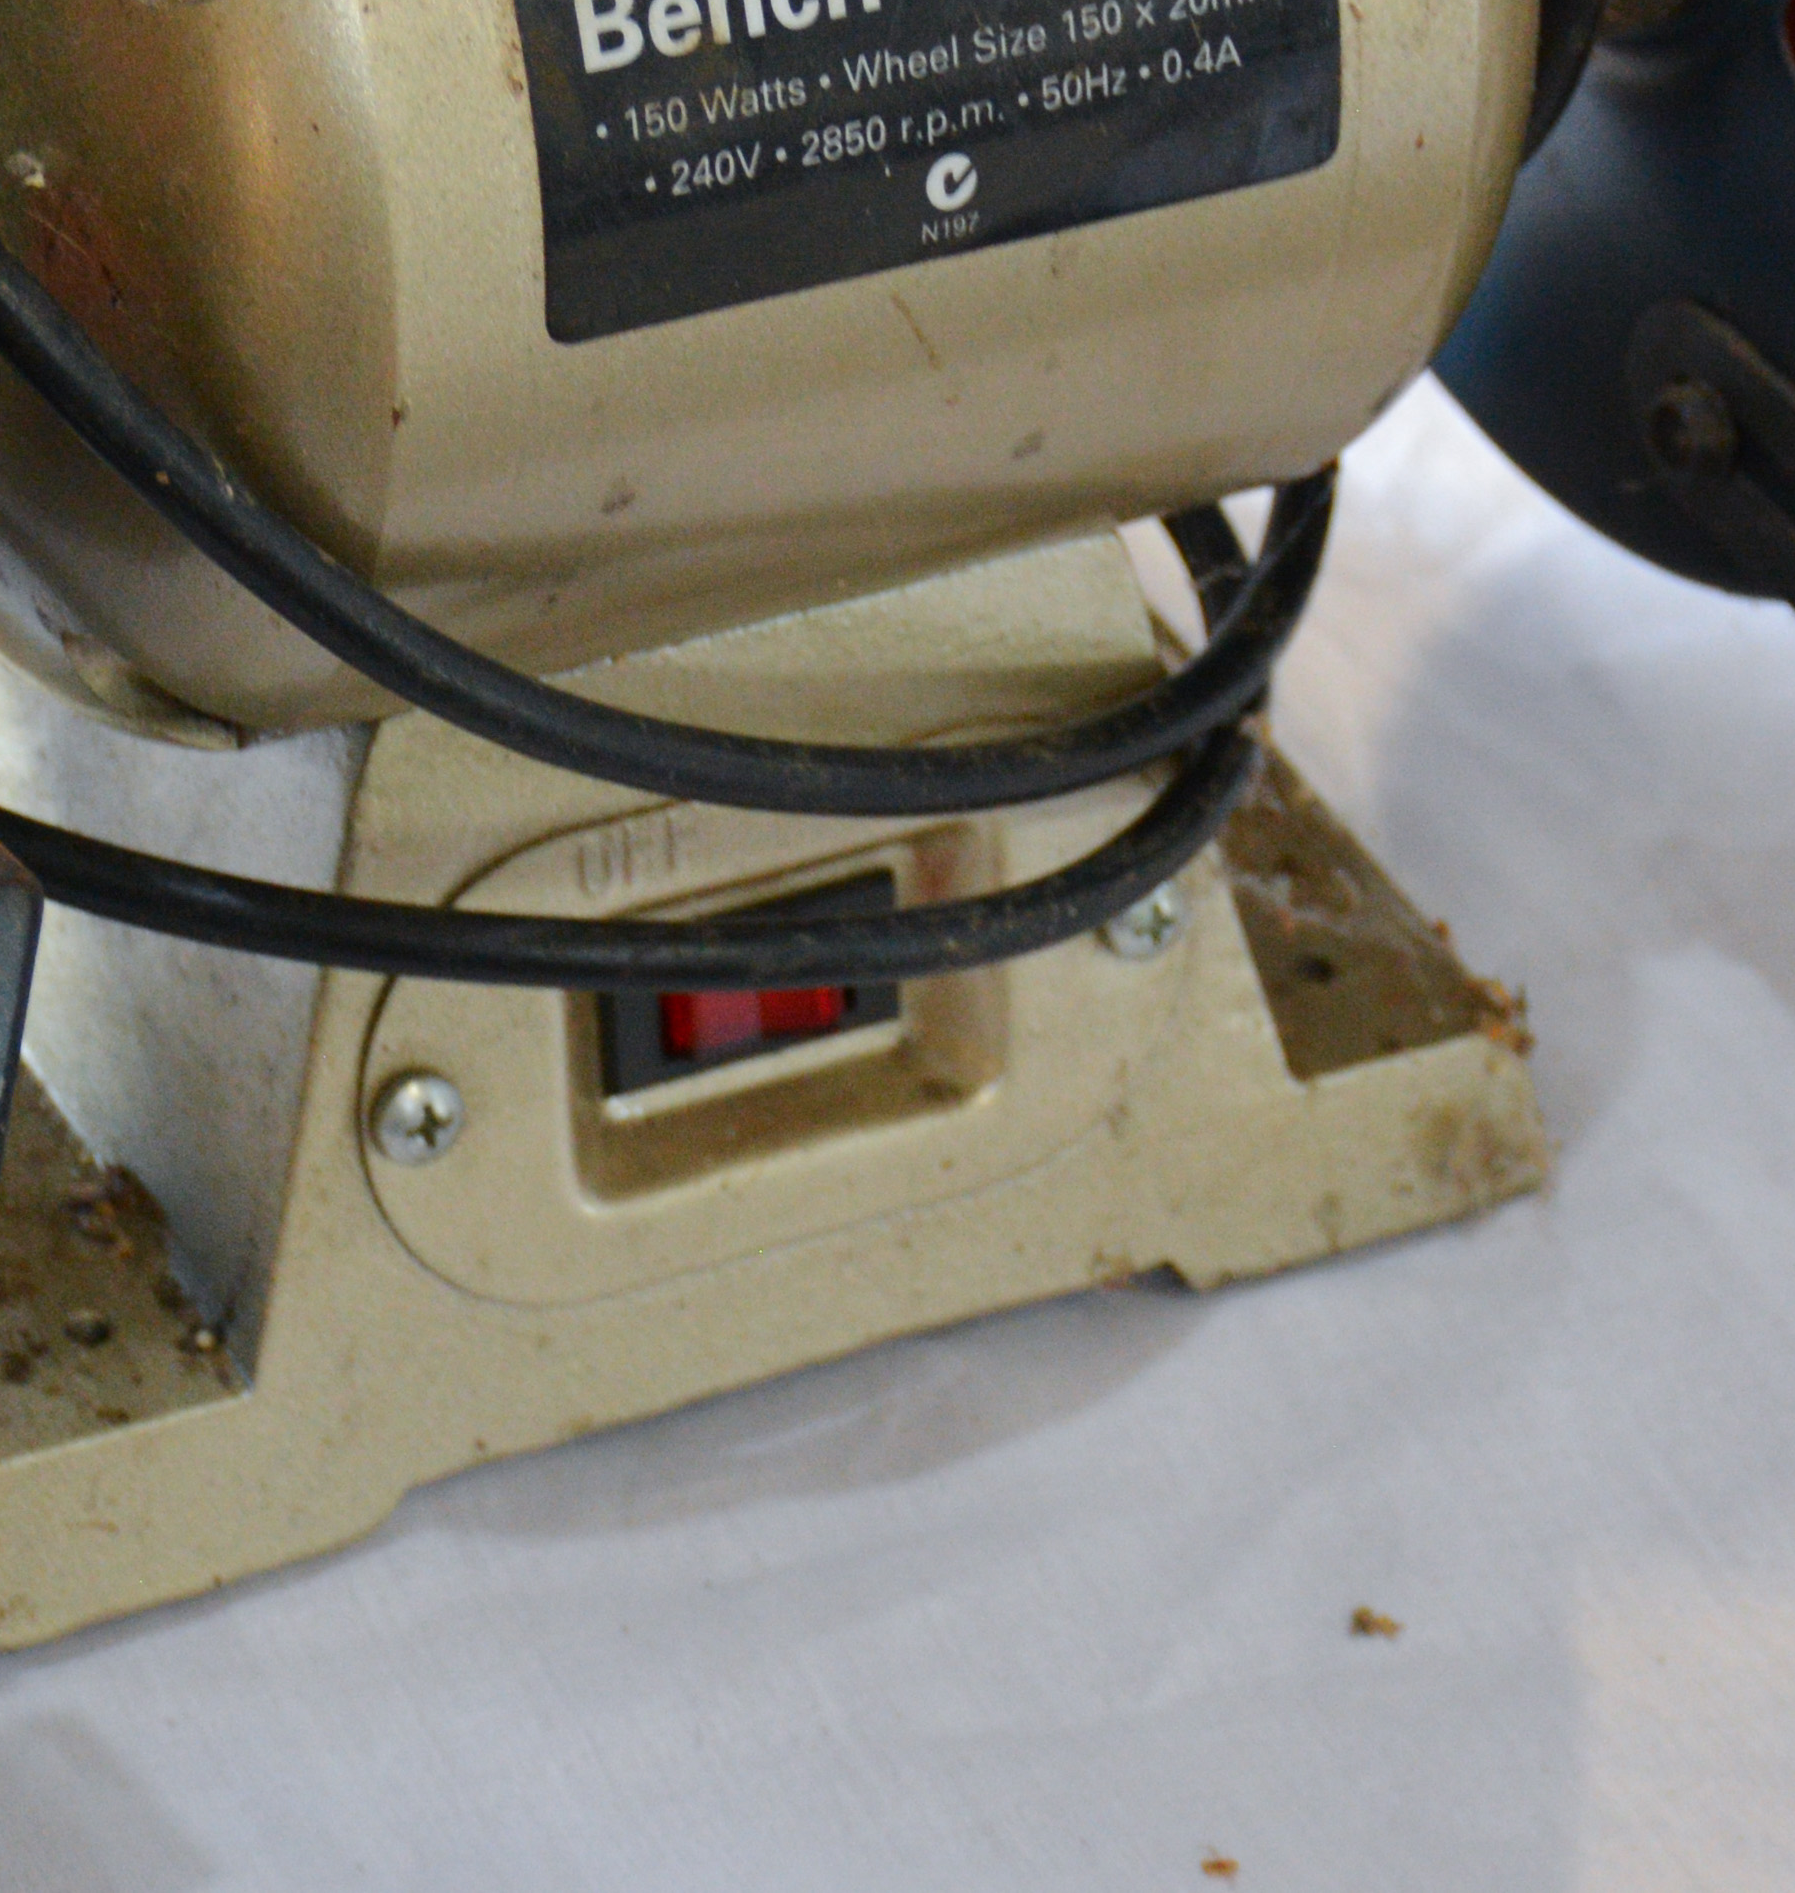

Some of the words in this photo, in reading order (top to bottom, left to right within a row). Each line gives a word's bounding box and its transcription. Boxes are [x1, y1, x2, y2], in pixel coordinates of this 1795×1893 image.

[624, 96, 688, 142] 150
[700, 76, 806, 125] Watts
[842, 35, 961, 93] Wheel
[973, 23, 1047, 65] Size
[1062, 0, 1123, 44] 150
[1135, 0, 1156, 29] x
[671, 141, 762, 197] 240V
[802, 115, 888, 167] 2850
[901, 96, 1005, 146] r.p.m.
[1042, 63, 1127, 111] 50Hz
[1162, 35, 1242, 84] 0.4A
